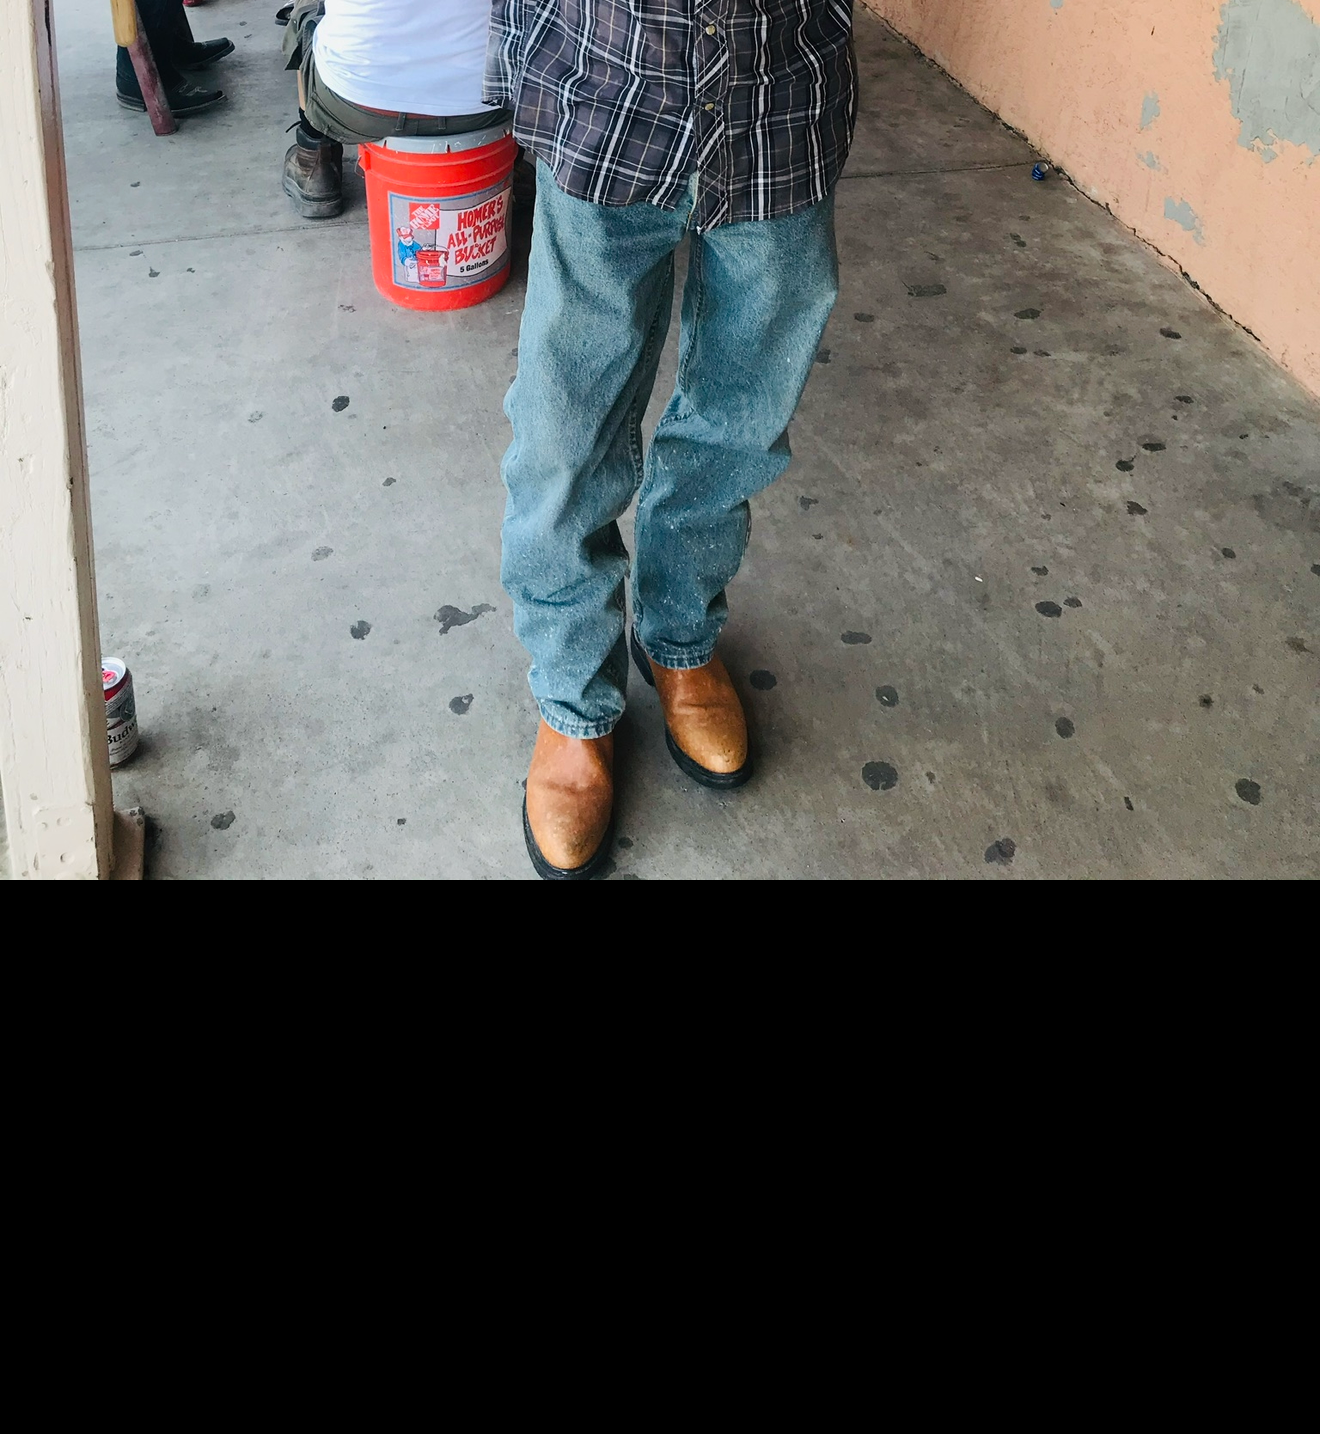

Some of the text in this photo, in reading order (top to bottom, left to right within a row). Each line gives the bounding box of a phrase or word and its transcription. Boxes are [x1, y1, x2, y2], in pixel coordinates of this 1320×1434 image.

[457, 195, 504, 232] HOMER'S
[455, 236, 497, 265] BUCKET
[466, 259, 489, 271] Gallons
